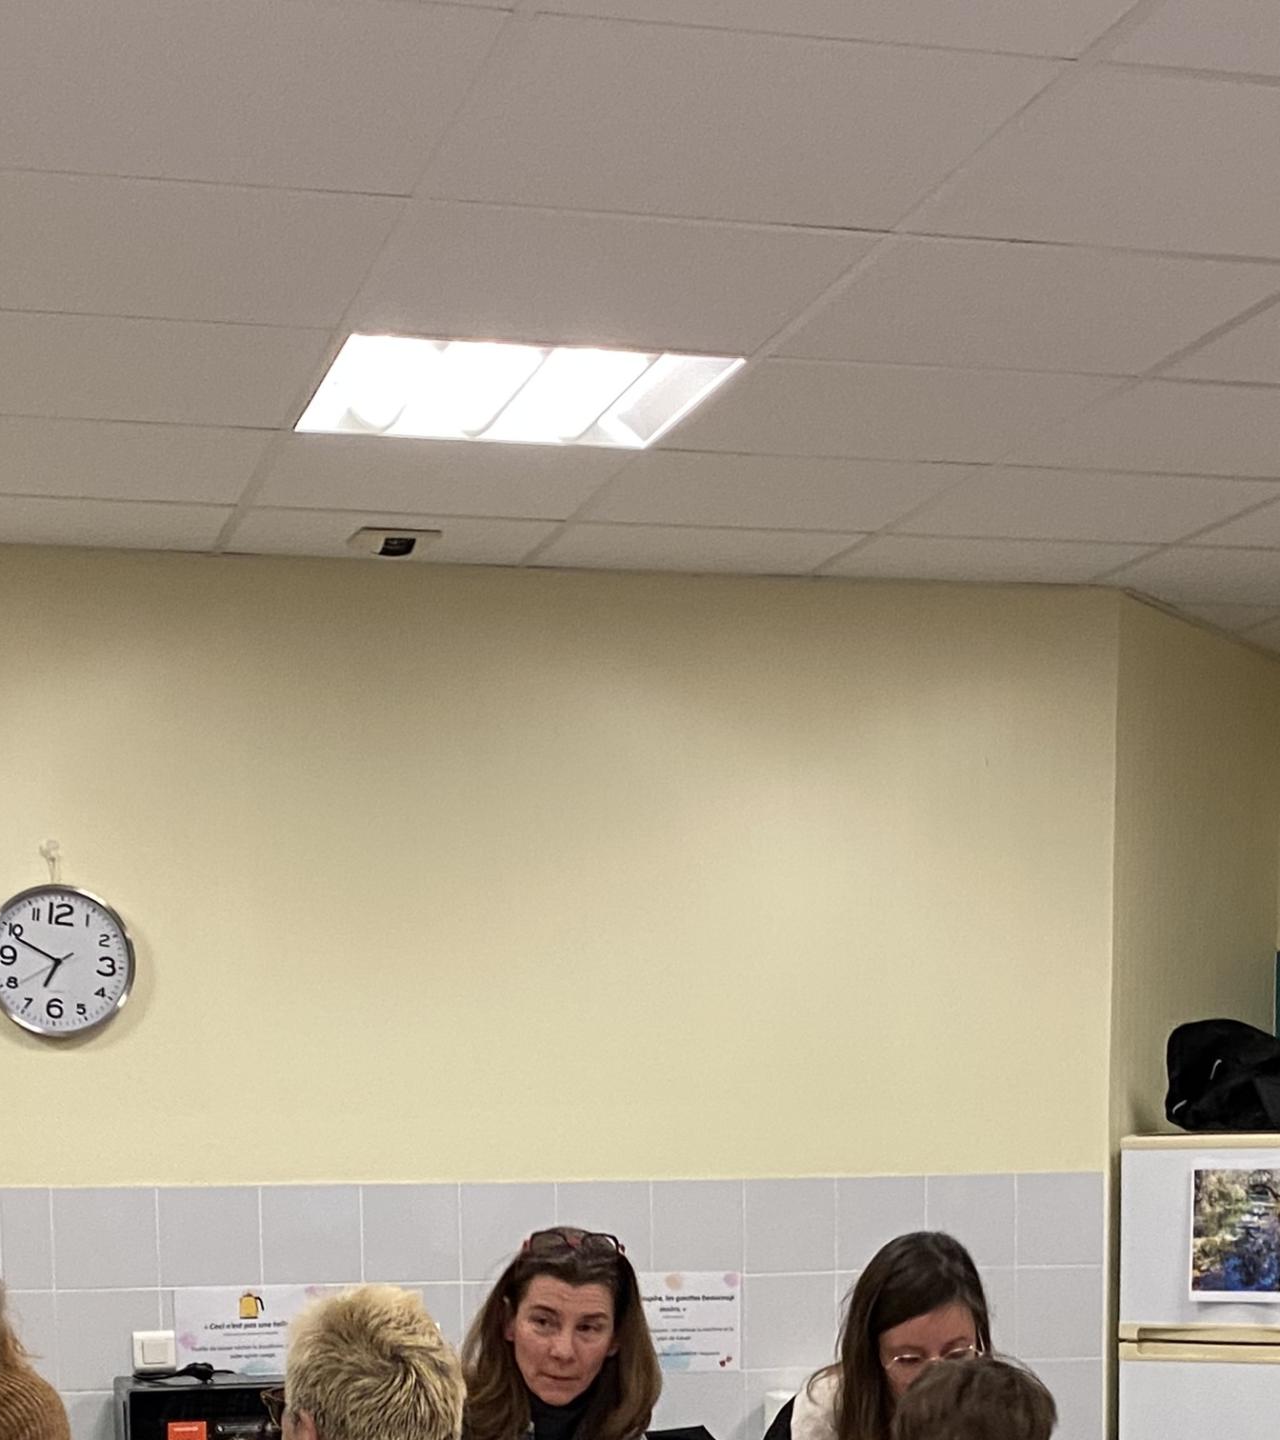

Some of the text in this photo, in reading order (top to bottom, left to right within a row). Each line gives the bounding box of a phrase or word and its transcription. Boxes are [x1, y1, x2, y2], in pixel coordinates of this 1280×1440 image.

[31, 907, 40, 921] 11
[48, 902, 74, 927] 12
[85, 914, 90, 928] 1
[8, 922, 24, 937] 10
[98, 934, 110, 947] 2
[0, 945, 17, 966] 9
[96, 956, 116, 977] 3
[6, 976, 18, 989] 8
[94, 987, 106, 998] 4
[24, 997, 34, 1009] 7
[46, 998, 64, 1019] 6
[76, 1003, 86, 1015] 5
